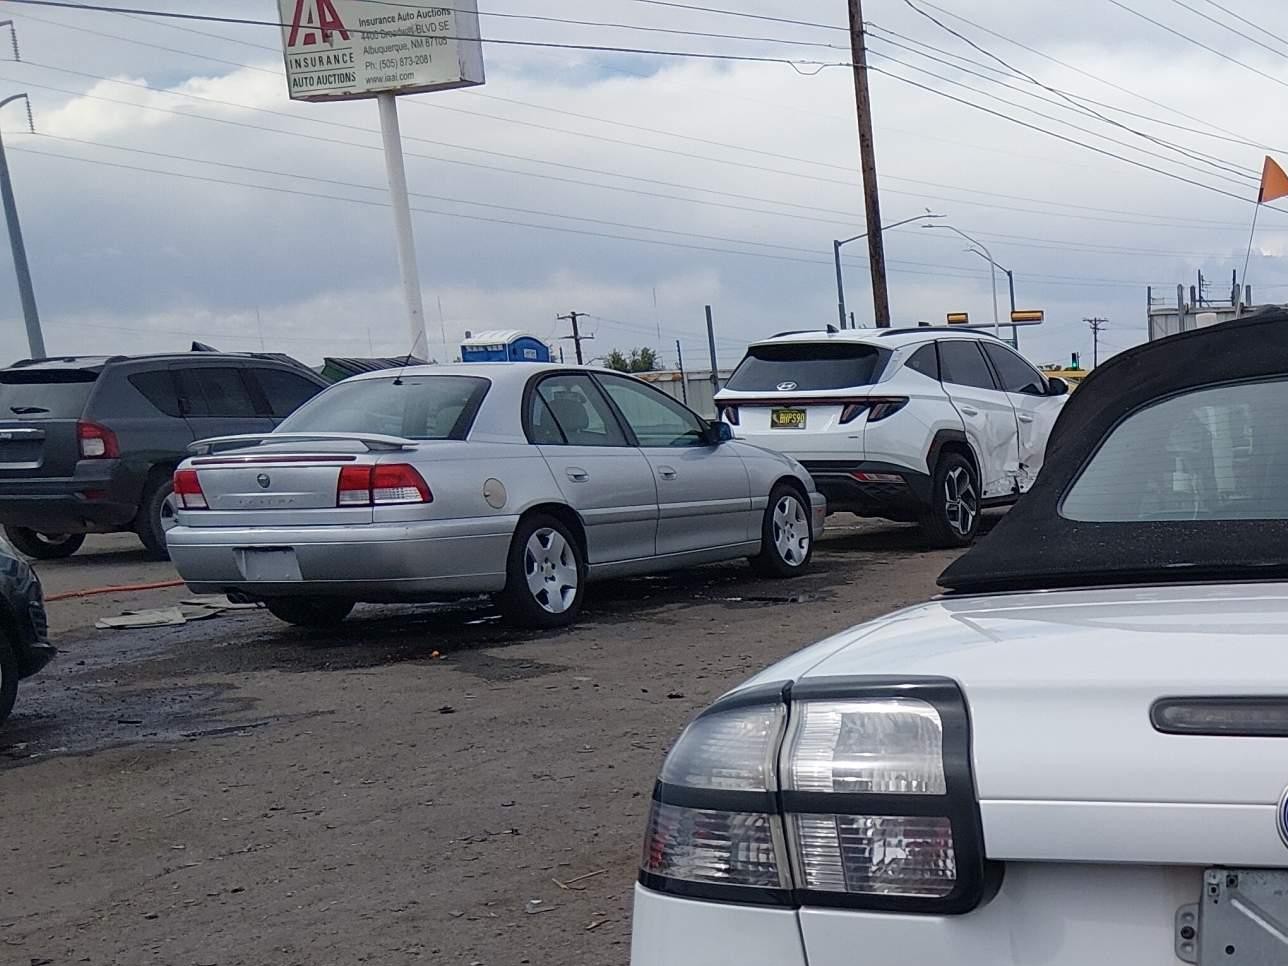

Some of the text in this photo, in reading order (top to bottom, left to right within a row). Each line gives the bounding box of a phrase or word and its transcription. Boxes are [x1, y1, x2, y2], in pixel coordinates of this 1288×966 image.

[359, 7, 451, 27] Insurance Auto Auctions
[415, 22, 437, 33] BLVD
[438, 20, 450, 31] SE
[363, 42, 410, 55] Albuquerque,
[410, 39, 424, 49] NM
[289, 52, 355, 70] INSURANCE
[379, 58, 398, 71] (505)
[292, 72, 357, 88] AUTO AUCTIONS
